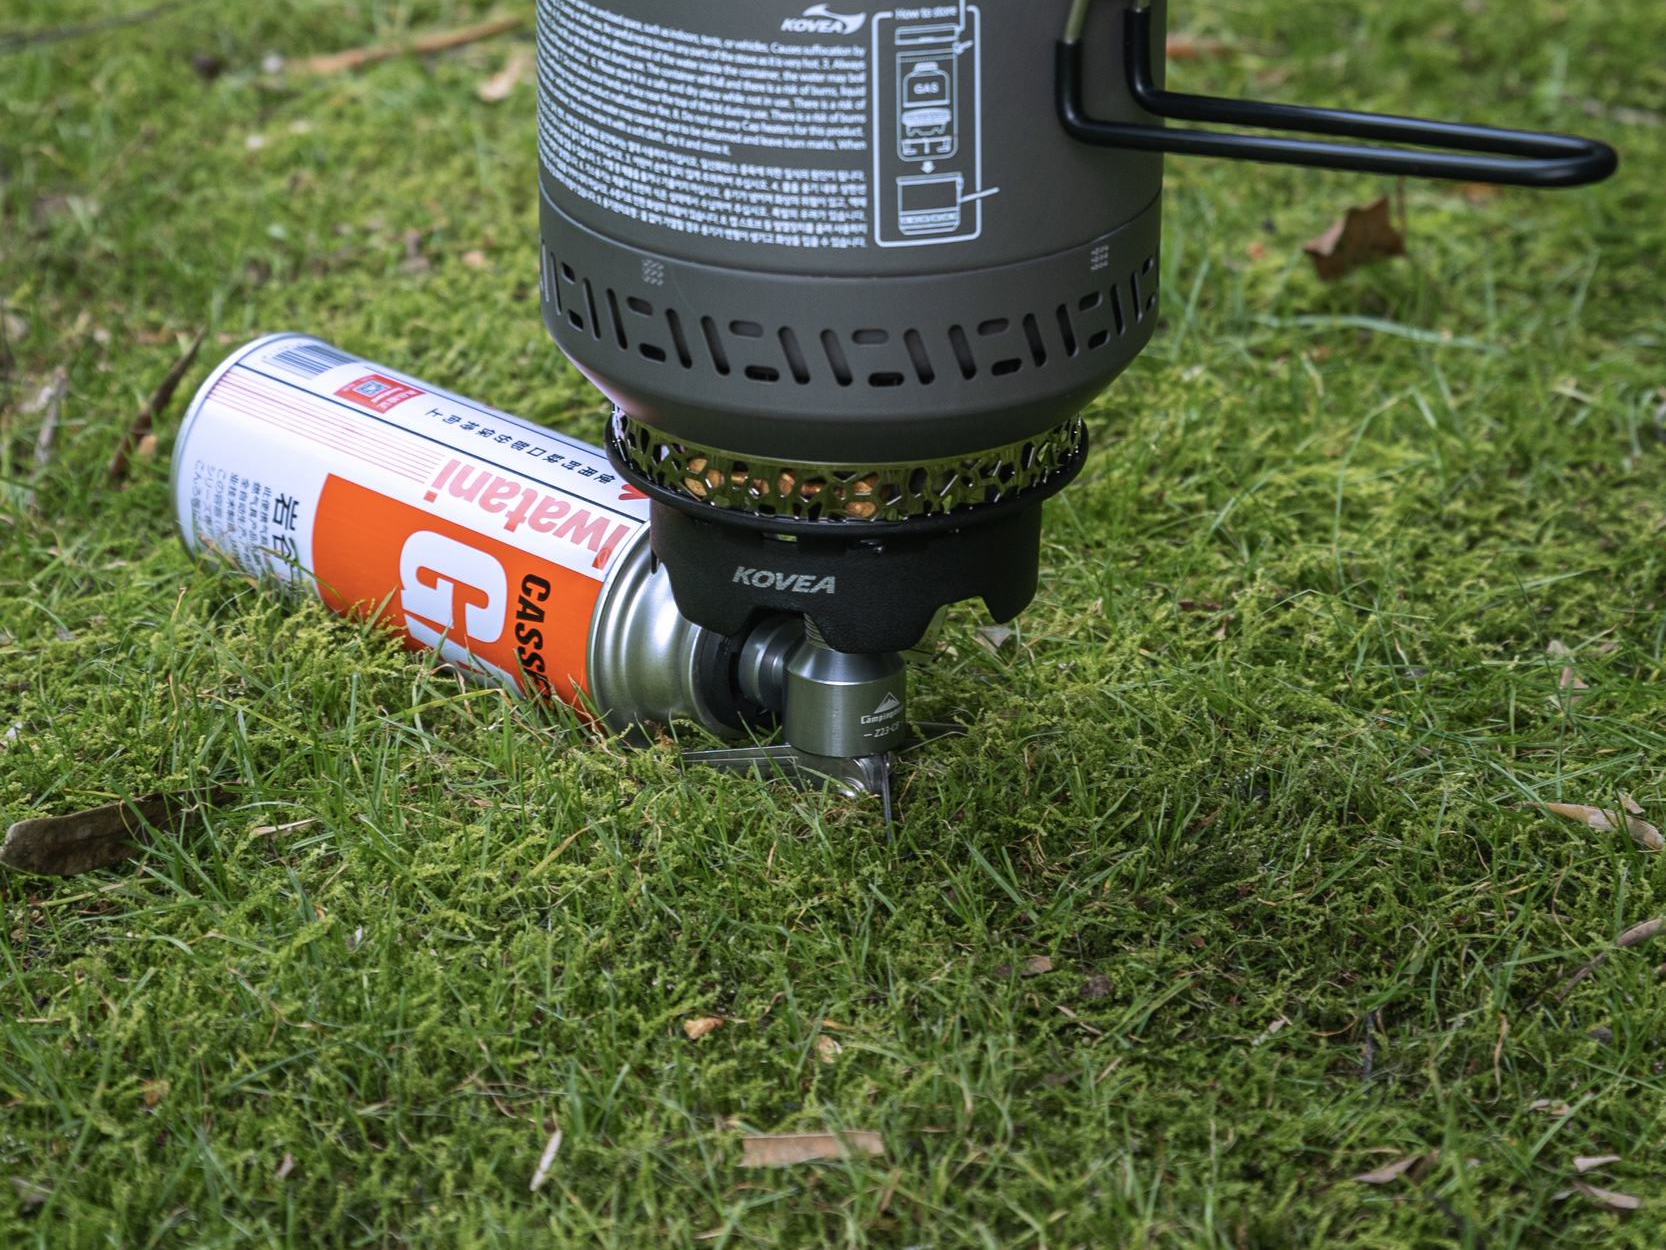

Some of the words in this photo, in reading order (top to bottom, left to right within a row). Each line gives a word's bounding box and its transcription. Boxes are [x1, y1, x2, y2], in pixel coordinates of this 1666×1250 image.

[895, 7, 920, 20] How
[921, 7, 932, 19] to
[780, 18, 844, 33] KOVEA
[913, 82, 939, 95] GAS
[423, 458, 631, 570] Iwatani
[732, 565, 837, 595] KOVEA
